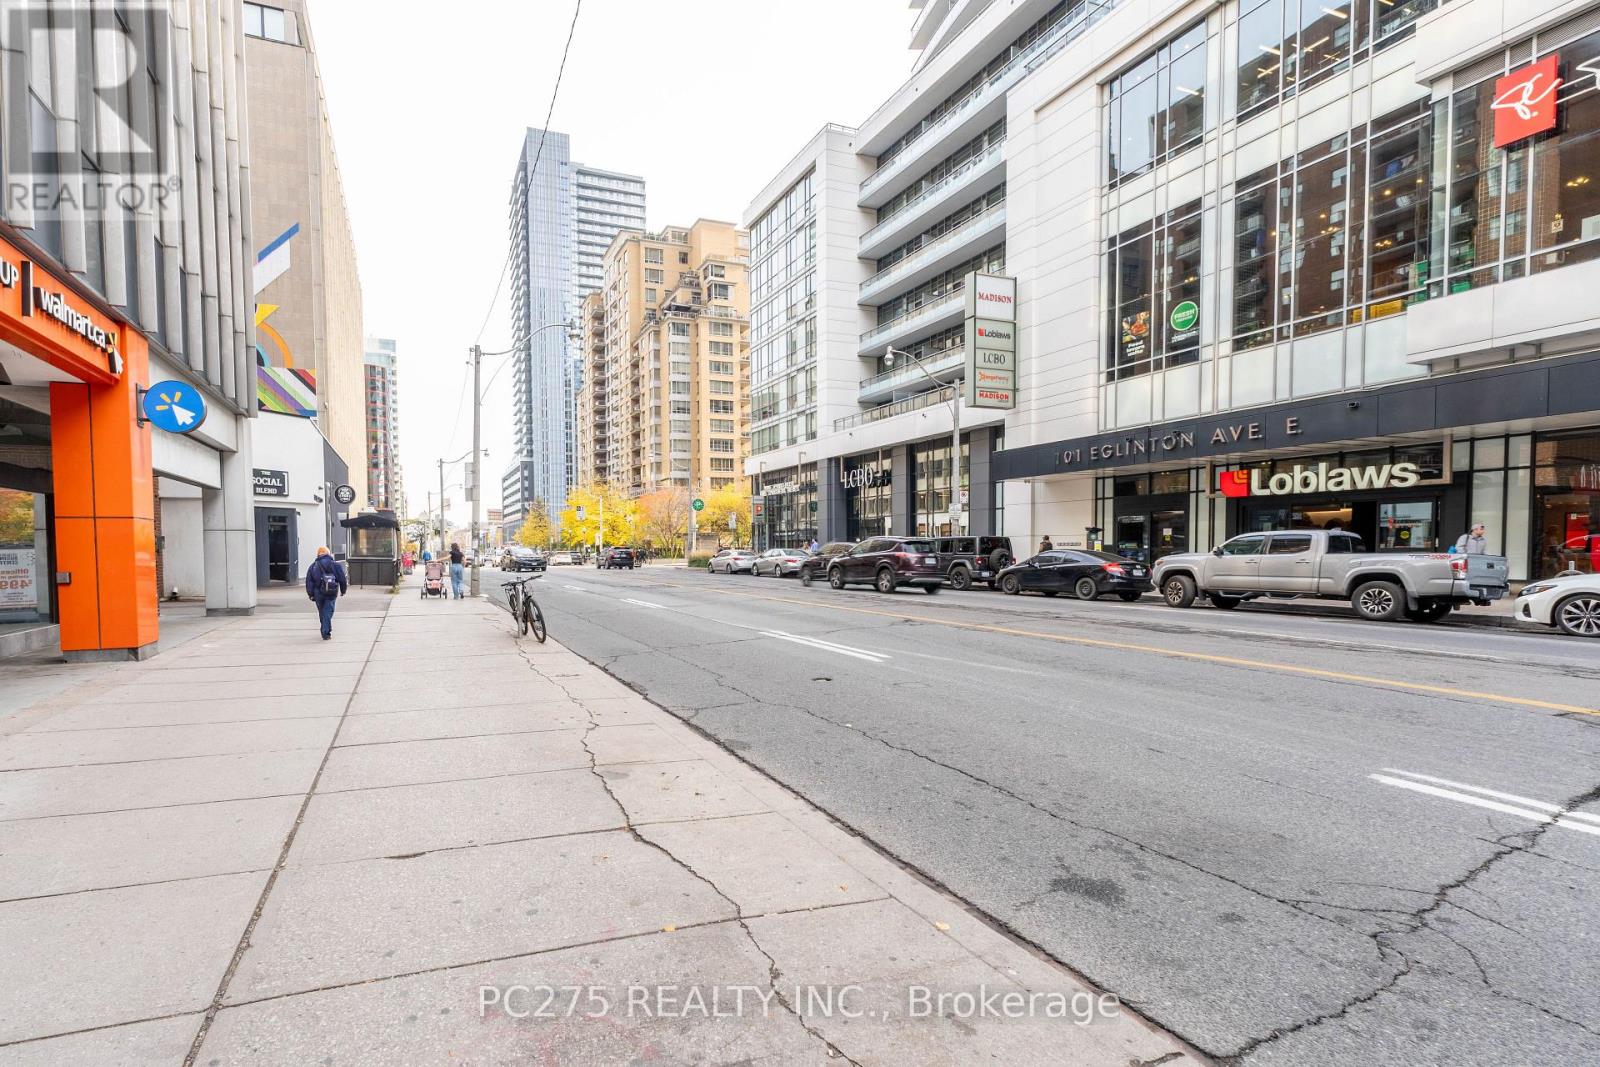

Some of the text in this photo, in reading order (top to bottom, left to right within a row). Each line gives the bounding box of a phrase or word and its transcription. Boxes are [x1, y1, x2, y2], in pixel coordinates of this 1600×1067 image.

[977, 291, 1012, 304] MADISON
[39, 287, 107, 350] walmart.ca
[984, 328, 1011, 340] Loblaws
[983, 352, 1006, 365] LCBO
[979, 391, 1009, 401] MADISON
[1055, 448, 1082, 465] 101
[1090, 431, 1195, 461] EGLINTON
[252, 476, 283, 487] SOCIAL
[844, 467, 873, 489] LCBO
[1250, 461, 1420, 496] Loblaws
[255, 487, 278, 495] BLEND
